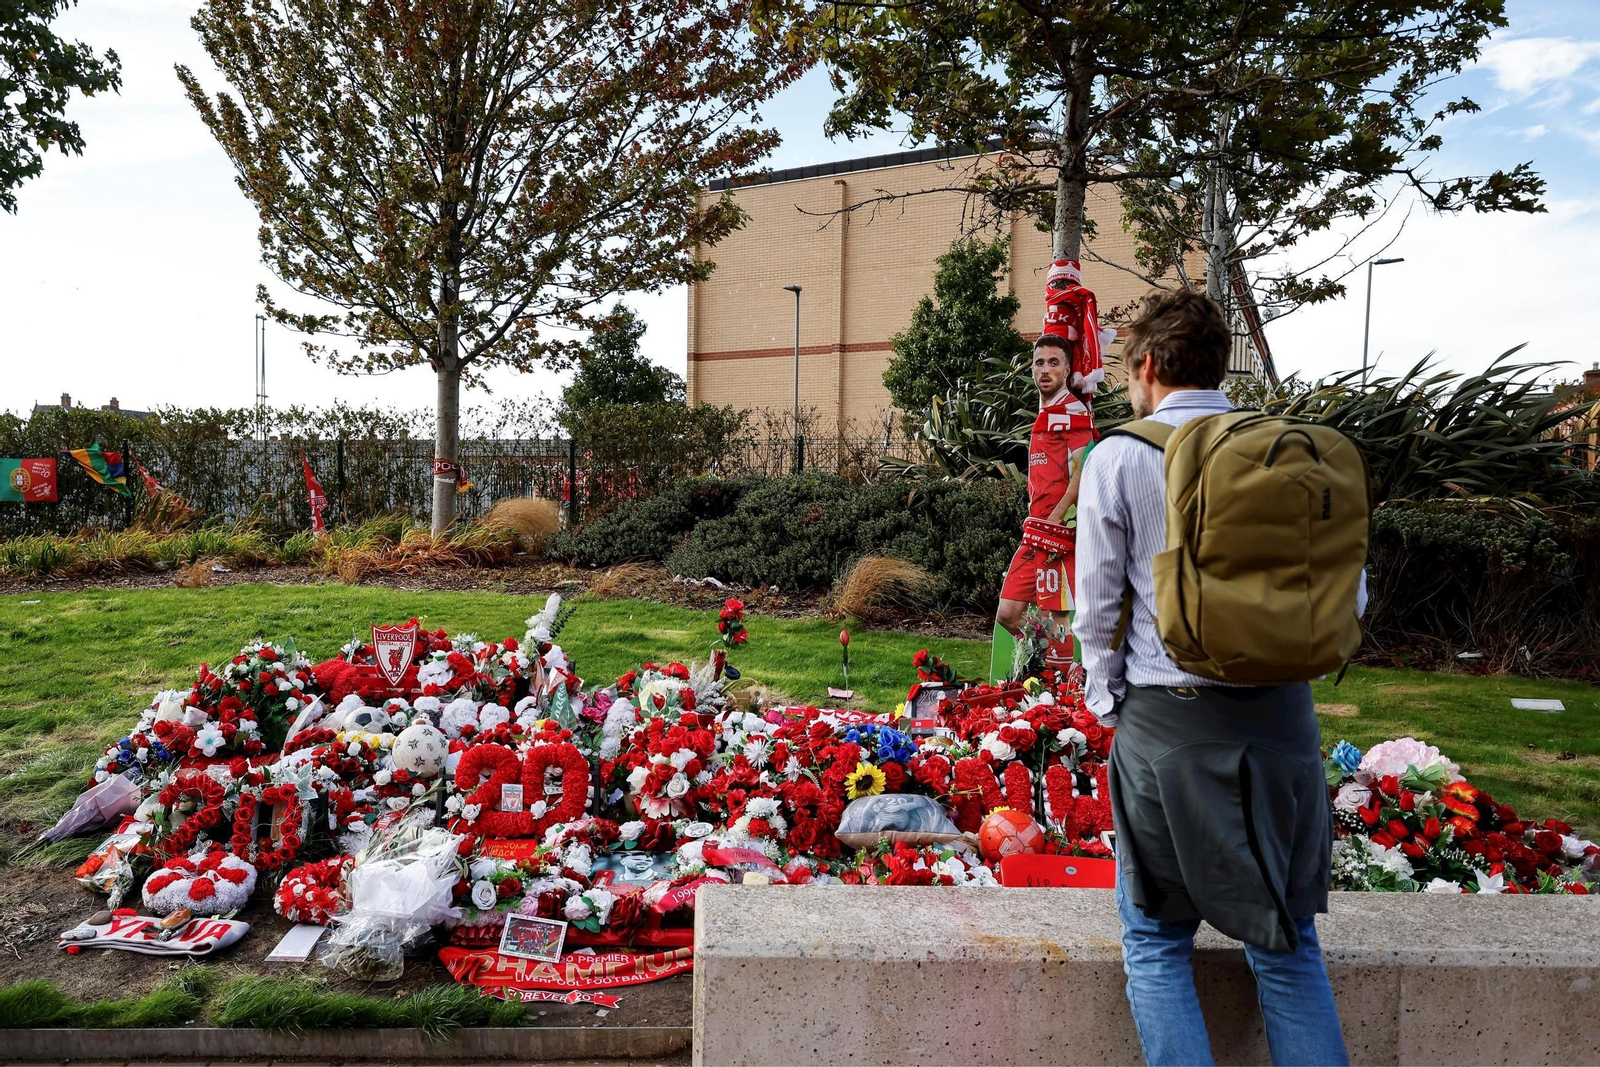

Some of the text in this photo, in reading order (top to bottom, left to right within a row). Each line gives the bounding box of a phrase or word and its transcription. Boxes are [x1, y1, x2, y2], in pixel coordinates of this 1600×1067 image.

[1036, 568, 1059, 593] 20
[376, 632, 412, 642] LIVERPOOL
[491, 848, 516, 857] BACK
[578, 953, 630, 964] PREMIER
[586, 973, 652, 986] FOOTBALL
[507, 988, 592, 1003] FOREVER 20
